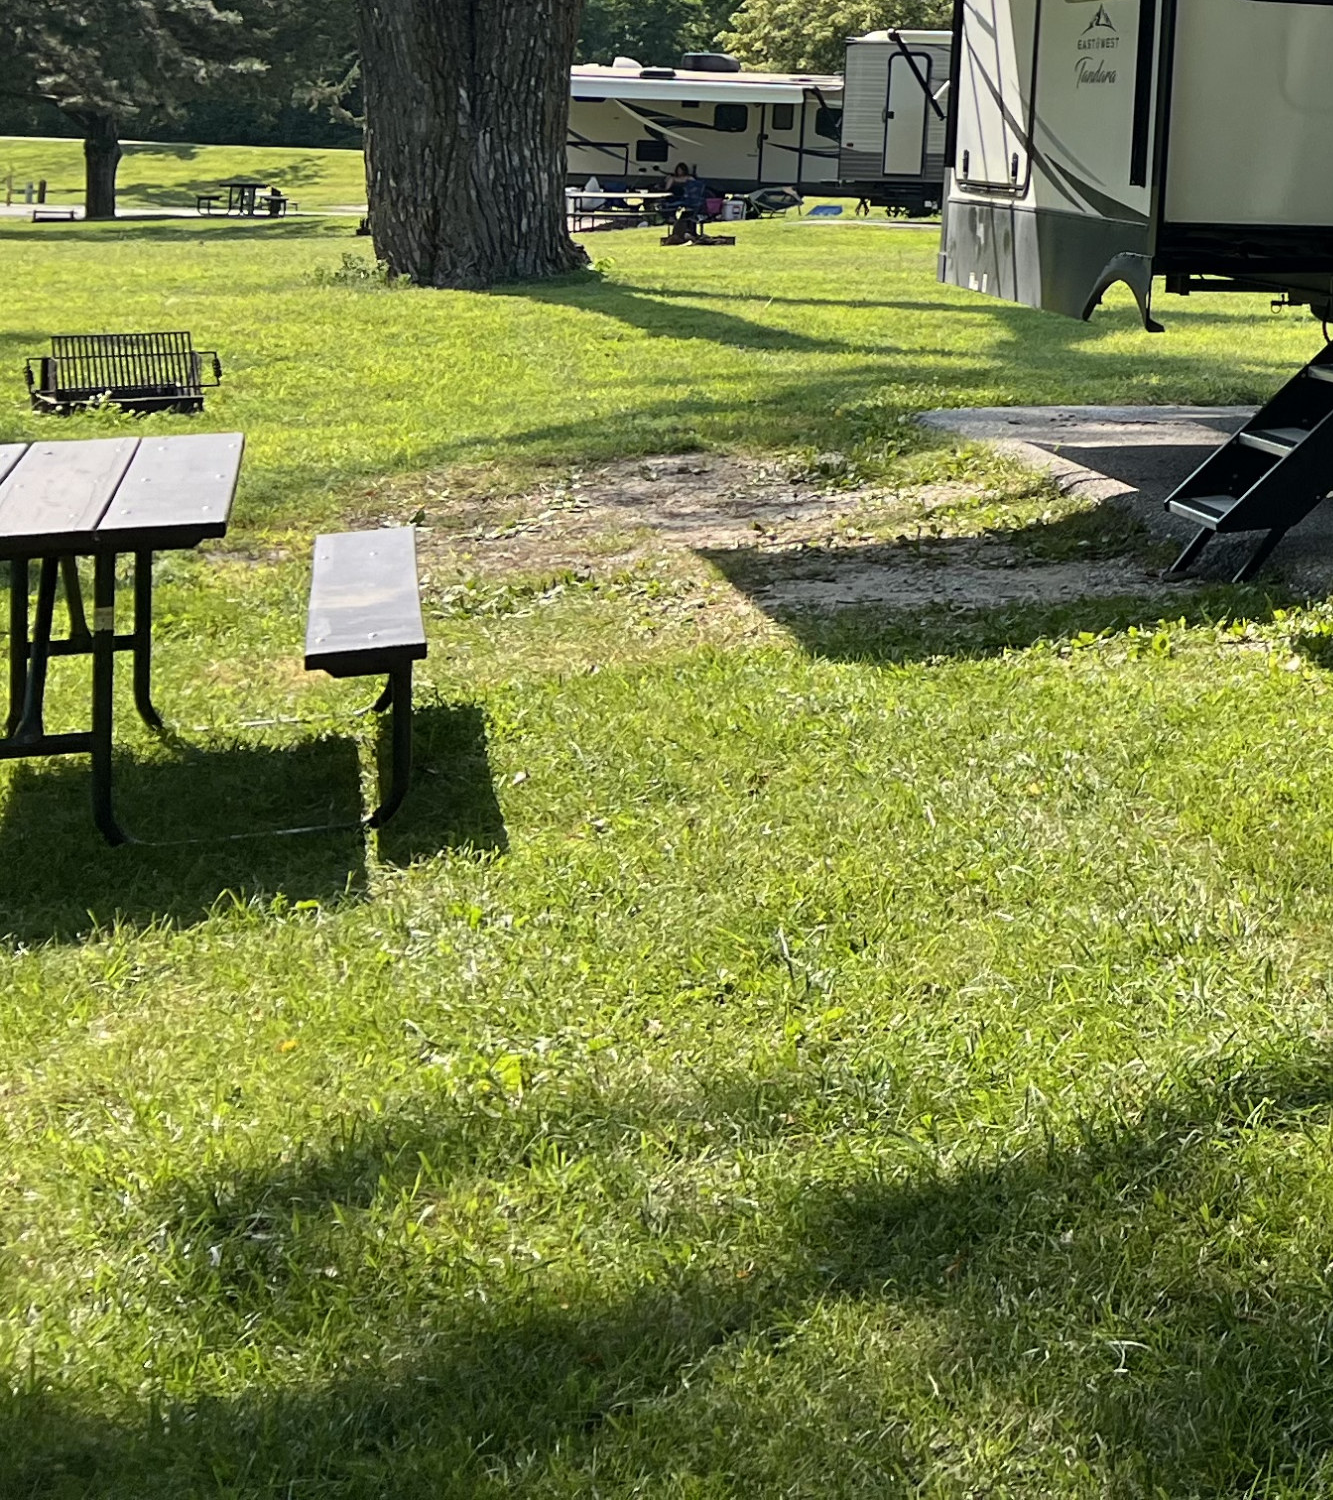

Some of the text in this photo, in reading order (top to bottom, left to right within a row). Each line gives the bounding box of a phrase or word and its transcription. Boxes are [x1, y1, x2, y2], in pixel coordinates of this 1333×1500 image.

[1077, 37, 1120, 50] EAST WEST
[1074, 56, 1117, 89] Tandara
